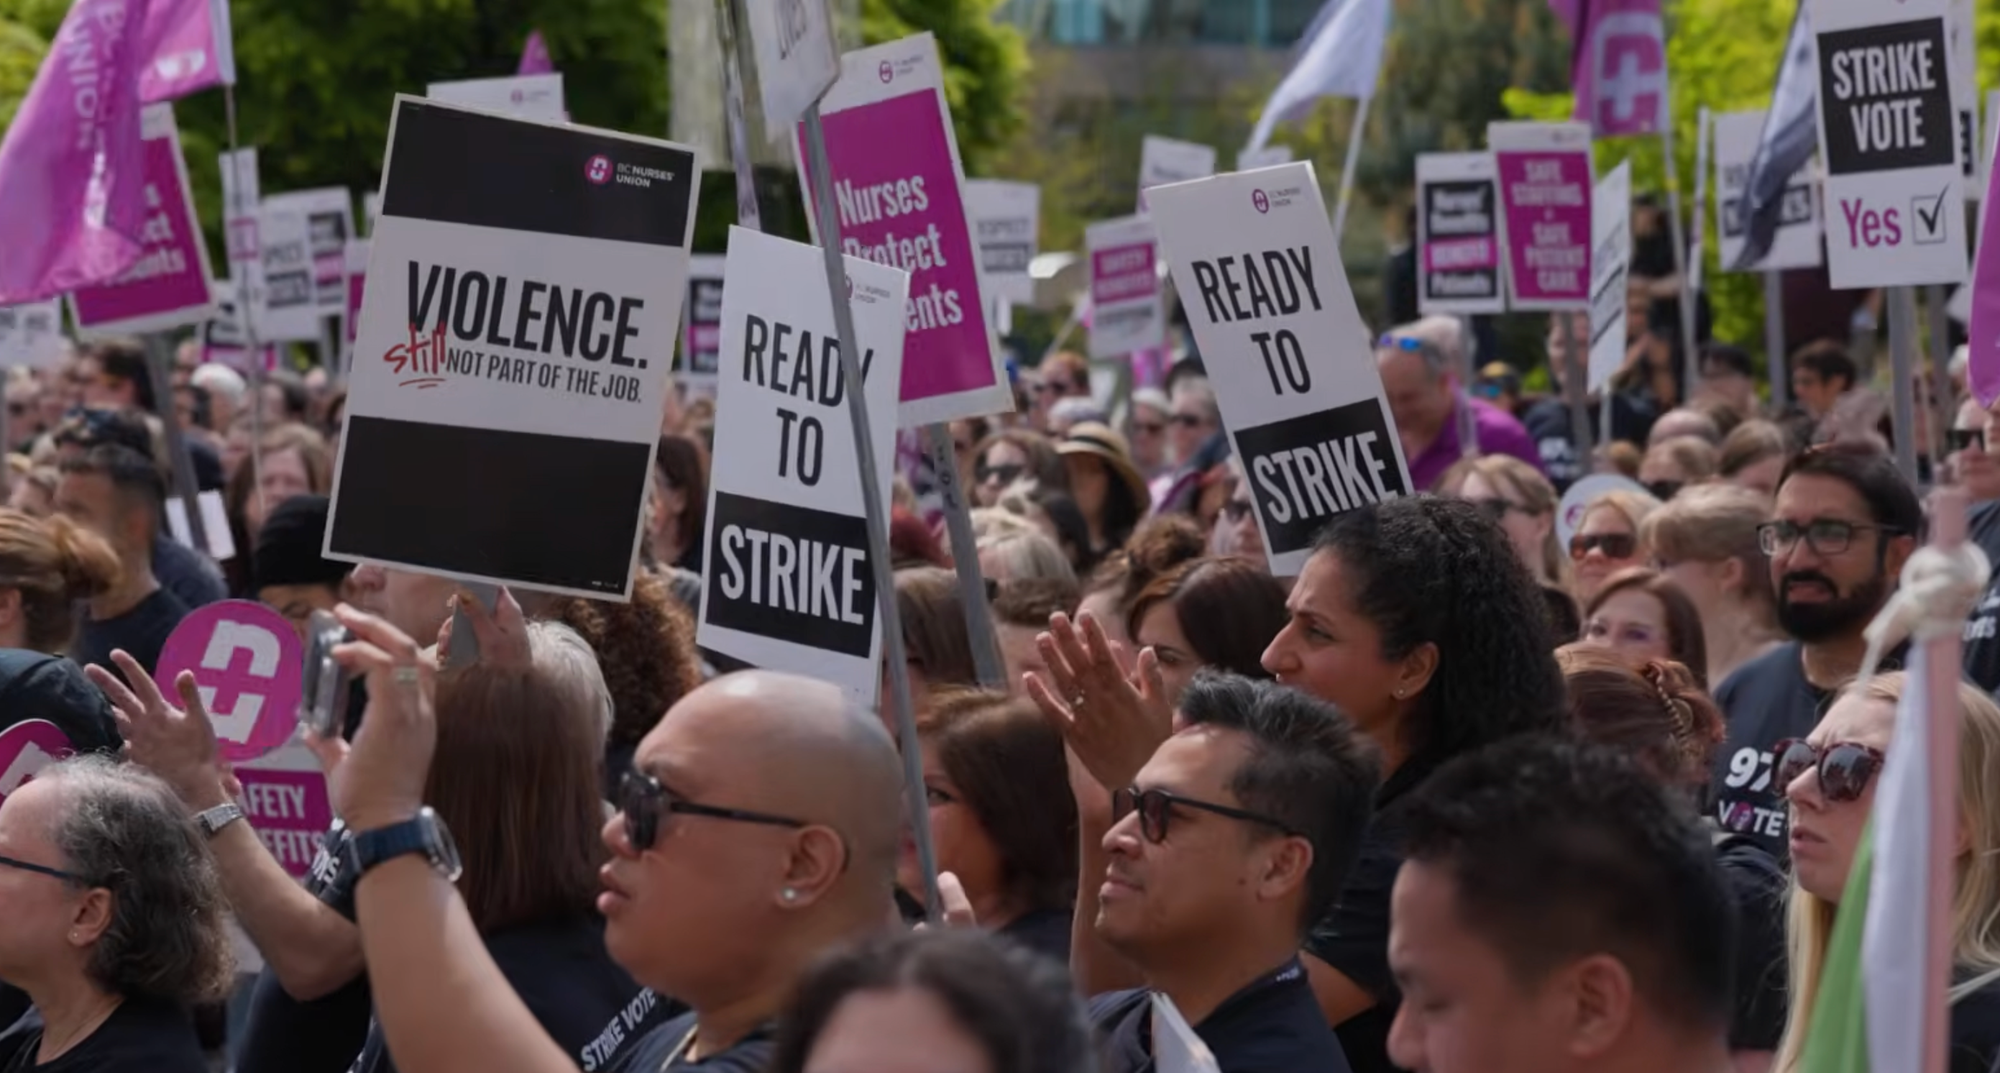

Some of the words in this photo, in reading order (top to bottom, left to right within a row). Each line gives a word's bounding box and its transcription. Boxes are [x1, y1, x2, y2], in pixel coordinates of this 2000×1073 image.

[1831, 40, 1936, 99] STRIKE
[1851, 99, 1925, 152] VOTE
[616, 174, 651, 188] UNION
[835, 175, 929, 227] Nurses
[1841, 198, 1902, 248] Yes
[905, 284, 963, 332] ents
[1191, 246, 1322, 324] READY
[408, 260, 648, 370] VIOLENCE.
[446, 348, 484, 377] NOT
[487, 354, 537, 386] PART
[538, 362, 562, 389] OF
[565, 367, 600, 397] THE
[602, 374, 642, 404] JOB.
[1250, 328, 1312, 396] TO
[777, 407, 824, 487] TO
[1253, 430, 1397, 524] STRIKE
[719, 523, 866, 625] STRIKE
[237, 783, 305, 819] AFETY
[581, 1015, 626, 1072] STRIKE
[620, 986, 656, 1031] VOTE
